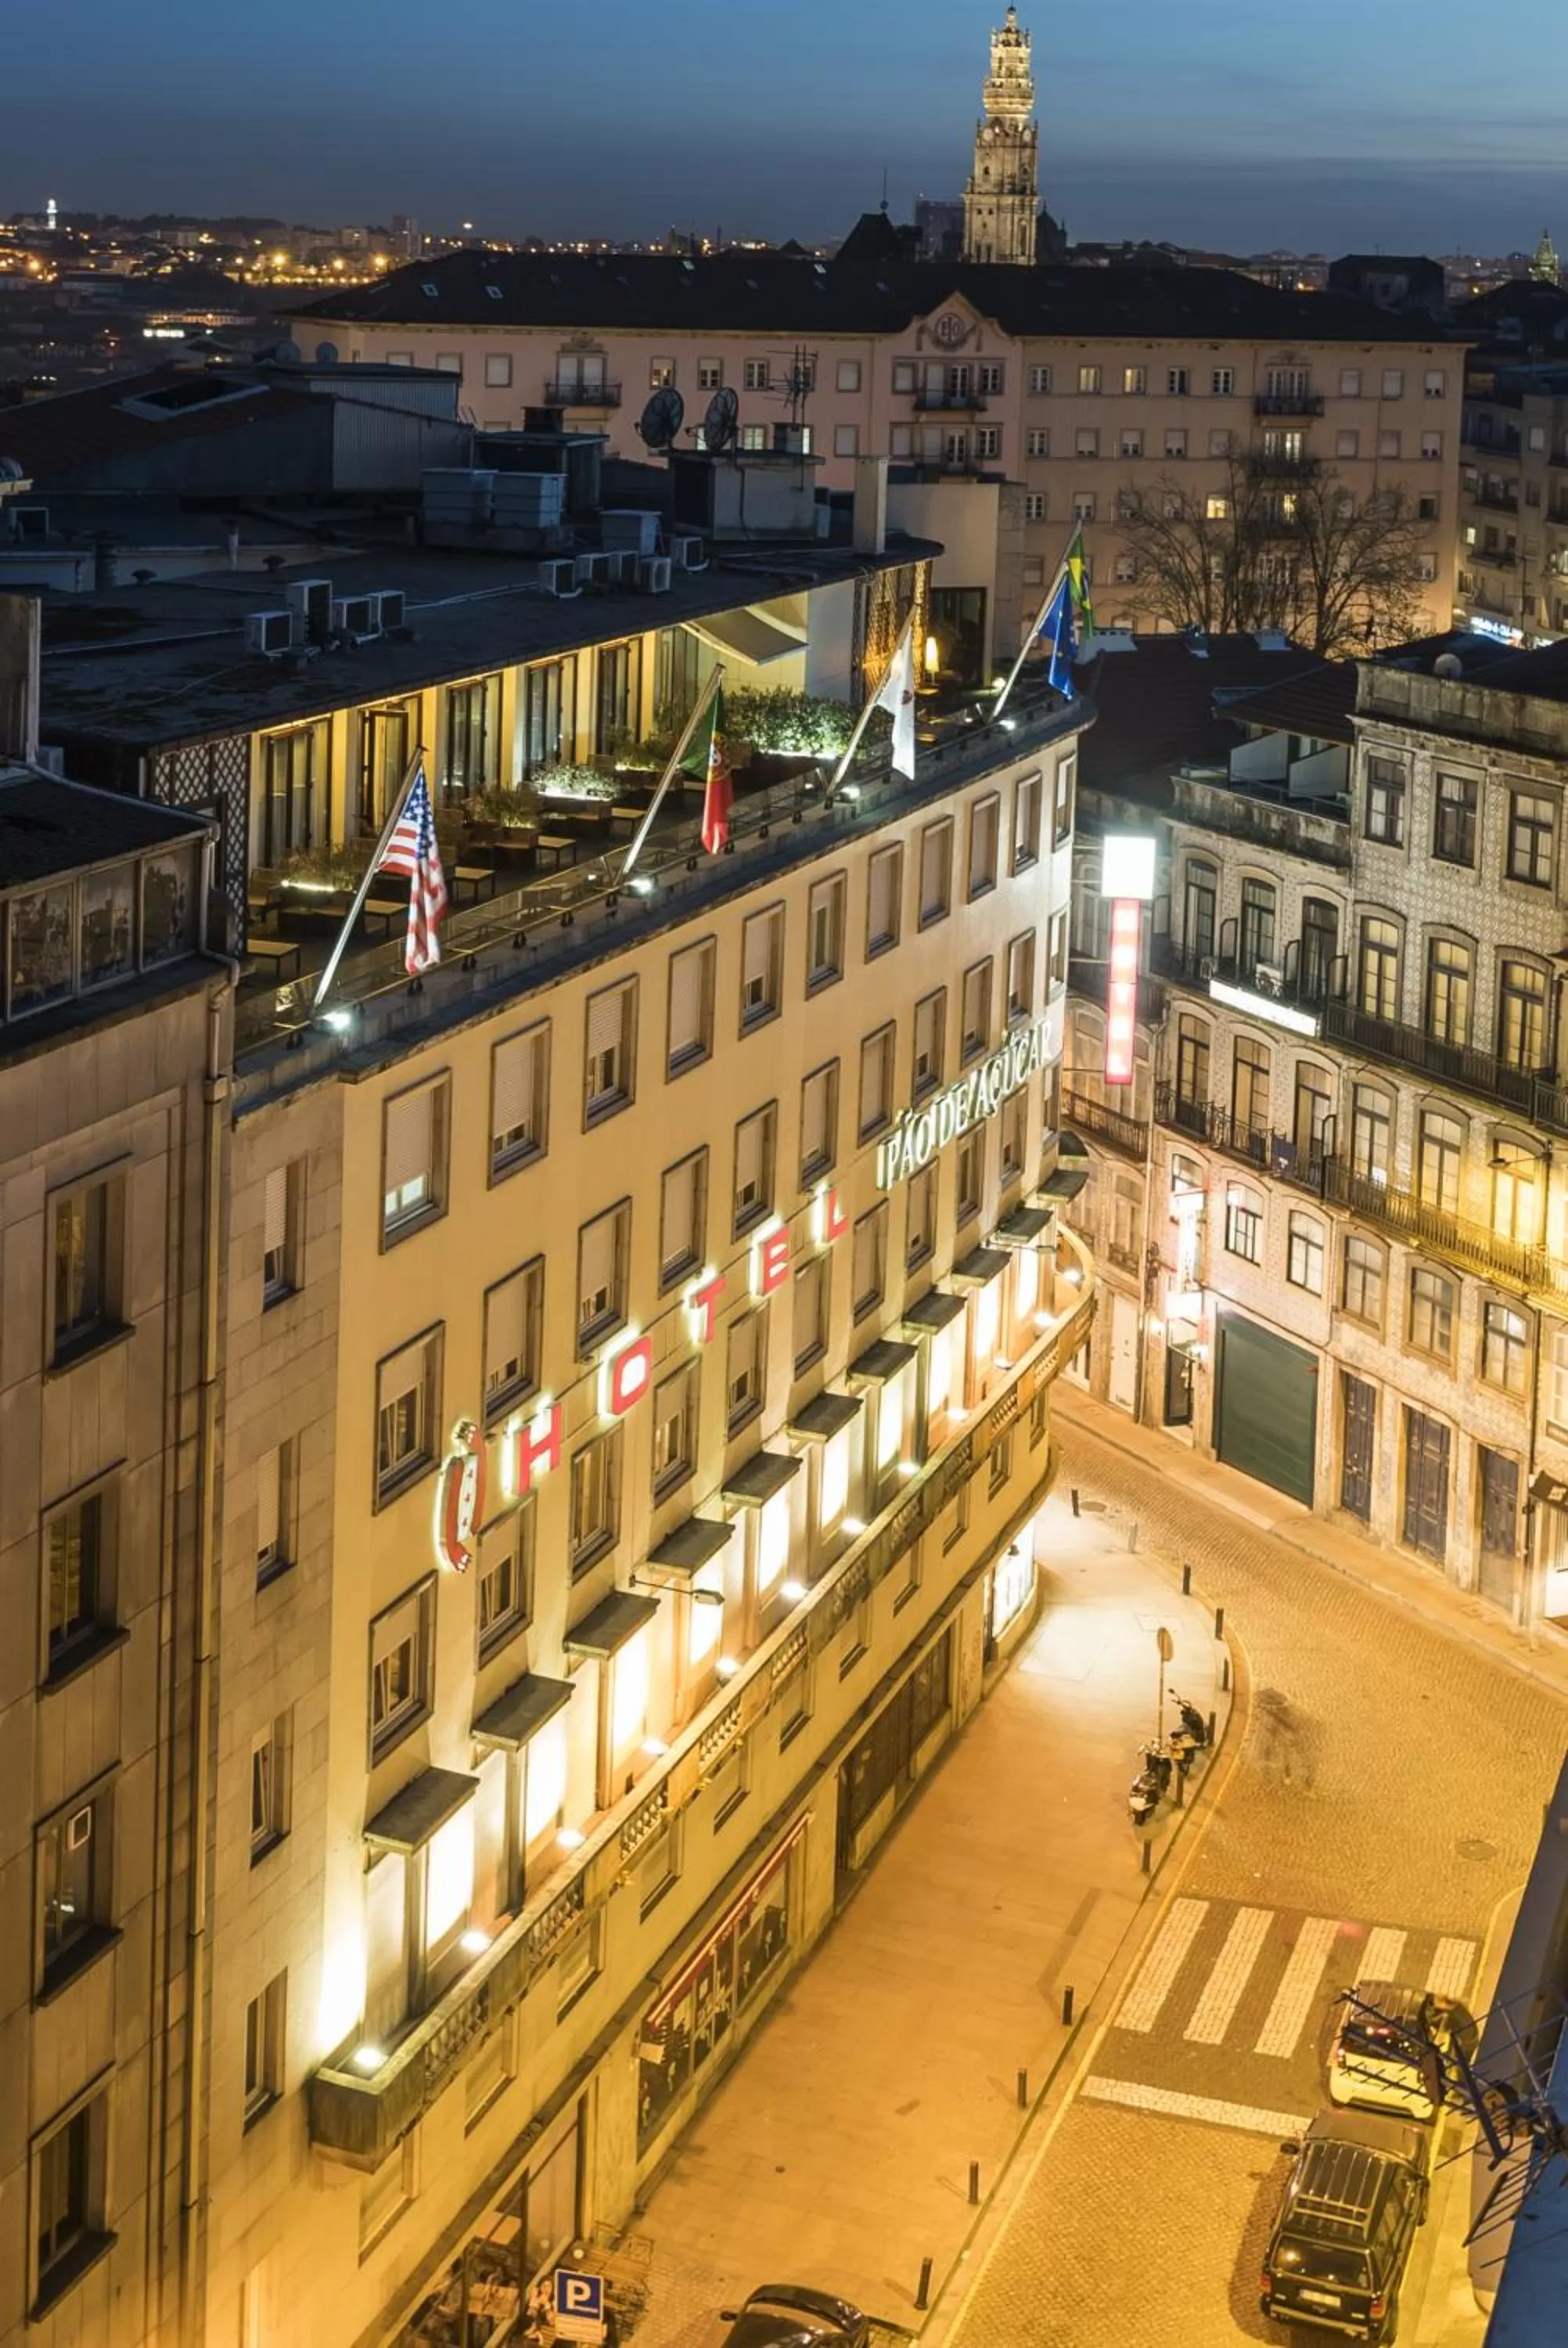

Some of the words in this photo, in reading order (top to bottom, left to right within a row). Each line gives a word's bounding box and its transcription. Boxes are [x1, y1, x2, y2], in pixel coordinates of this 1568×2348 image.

[518, 1188, 850, 1494] HOTEL
[939, 1086, 969, 1147] DE
[566, 2278, 591, 2310] P
